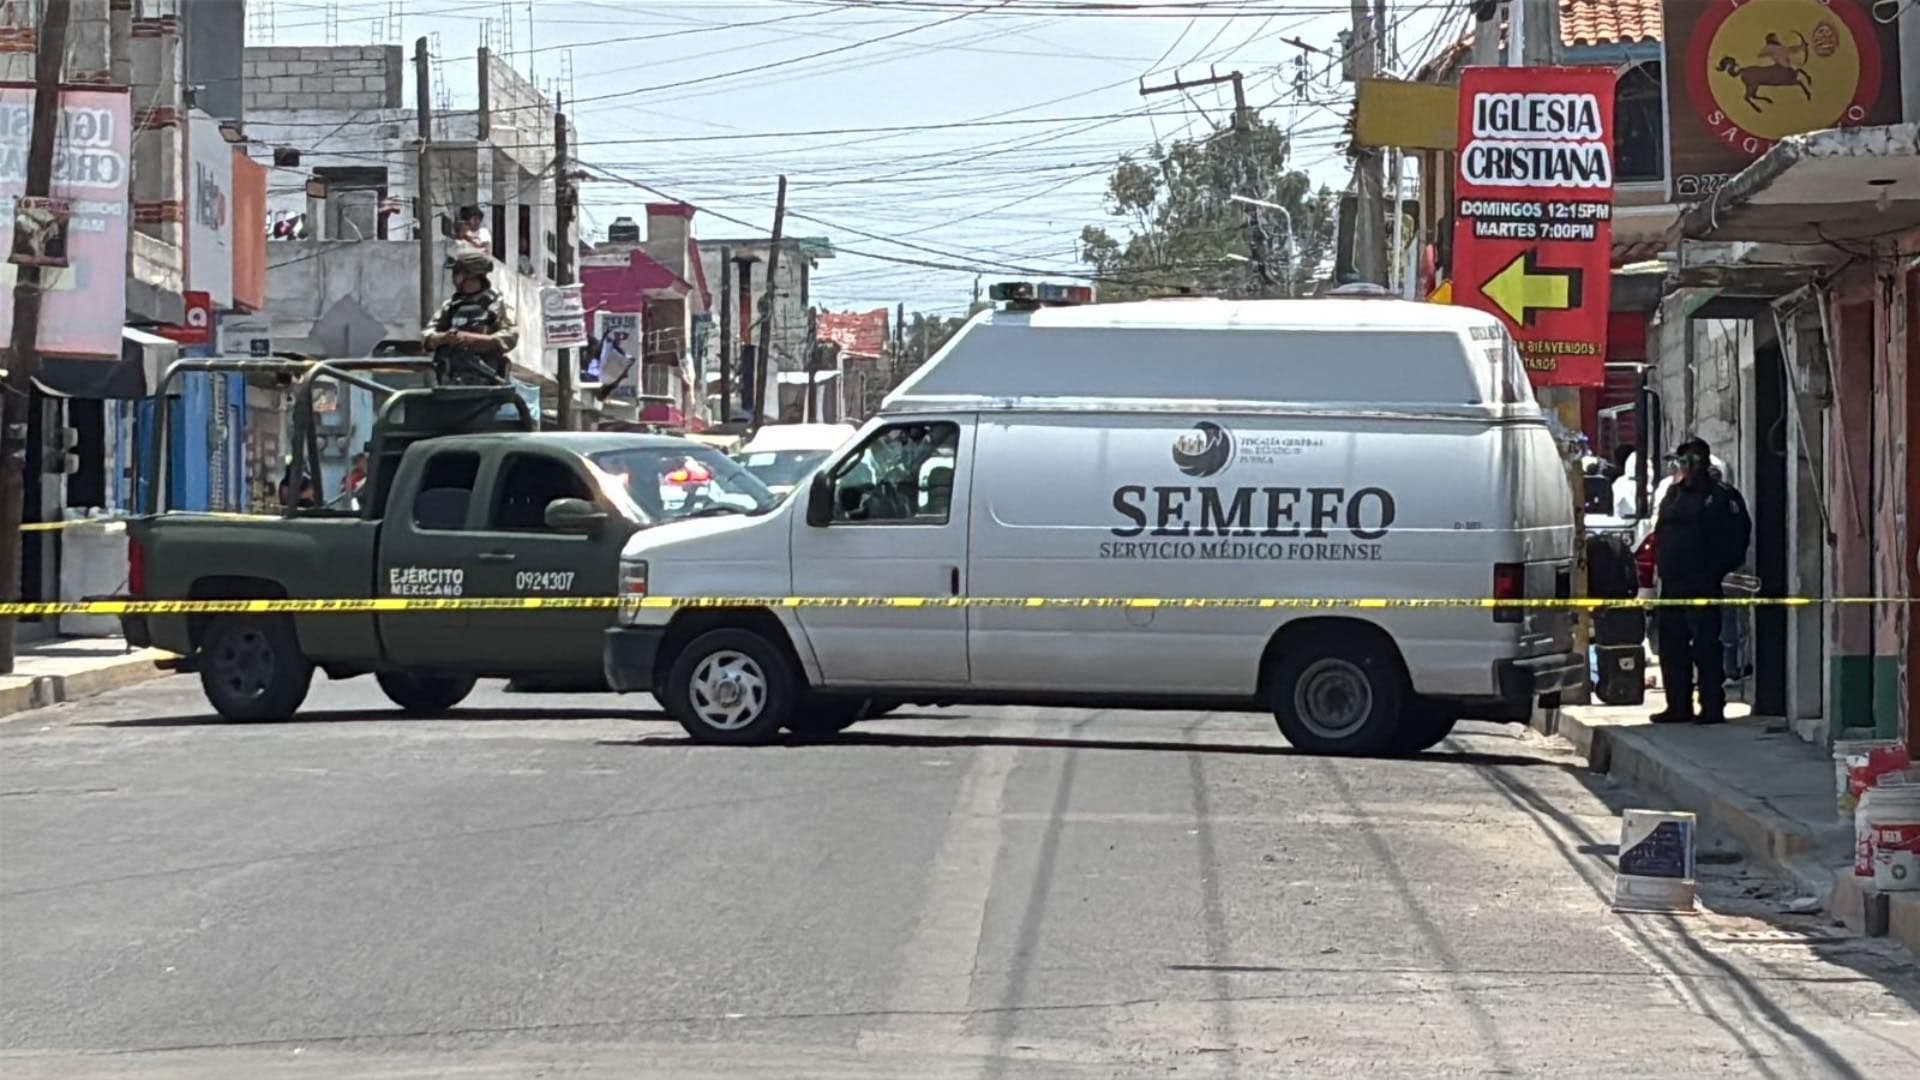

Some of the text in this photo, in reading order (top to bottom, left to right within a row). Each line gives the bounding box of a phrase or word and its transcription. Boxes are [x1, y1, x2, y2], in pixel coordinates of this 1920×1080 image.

[1477, 98, 1597, 134] IGLESIA
[1466, 148, 1607, 182] CRISTIANA
[1461, 202, 1609, 220] DOMINGOS 12:15PM
[1475, 222, 1594, 239] MARTES 7:00PM
[1528, 341, 1596, 355] BIENVENIDOS
[1110, 485, 1396, 540] SEMEFO
[1099, 539, 1382, 561] SERVICIO MÉDICO FORENSE
[389, 567, 464, 584] EJÉRCITO
[515, 571, 575, 591] 0924307
[390, 585, 463, 596] MEXICANO
